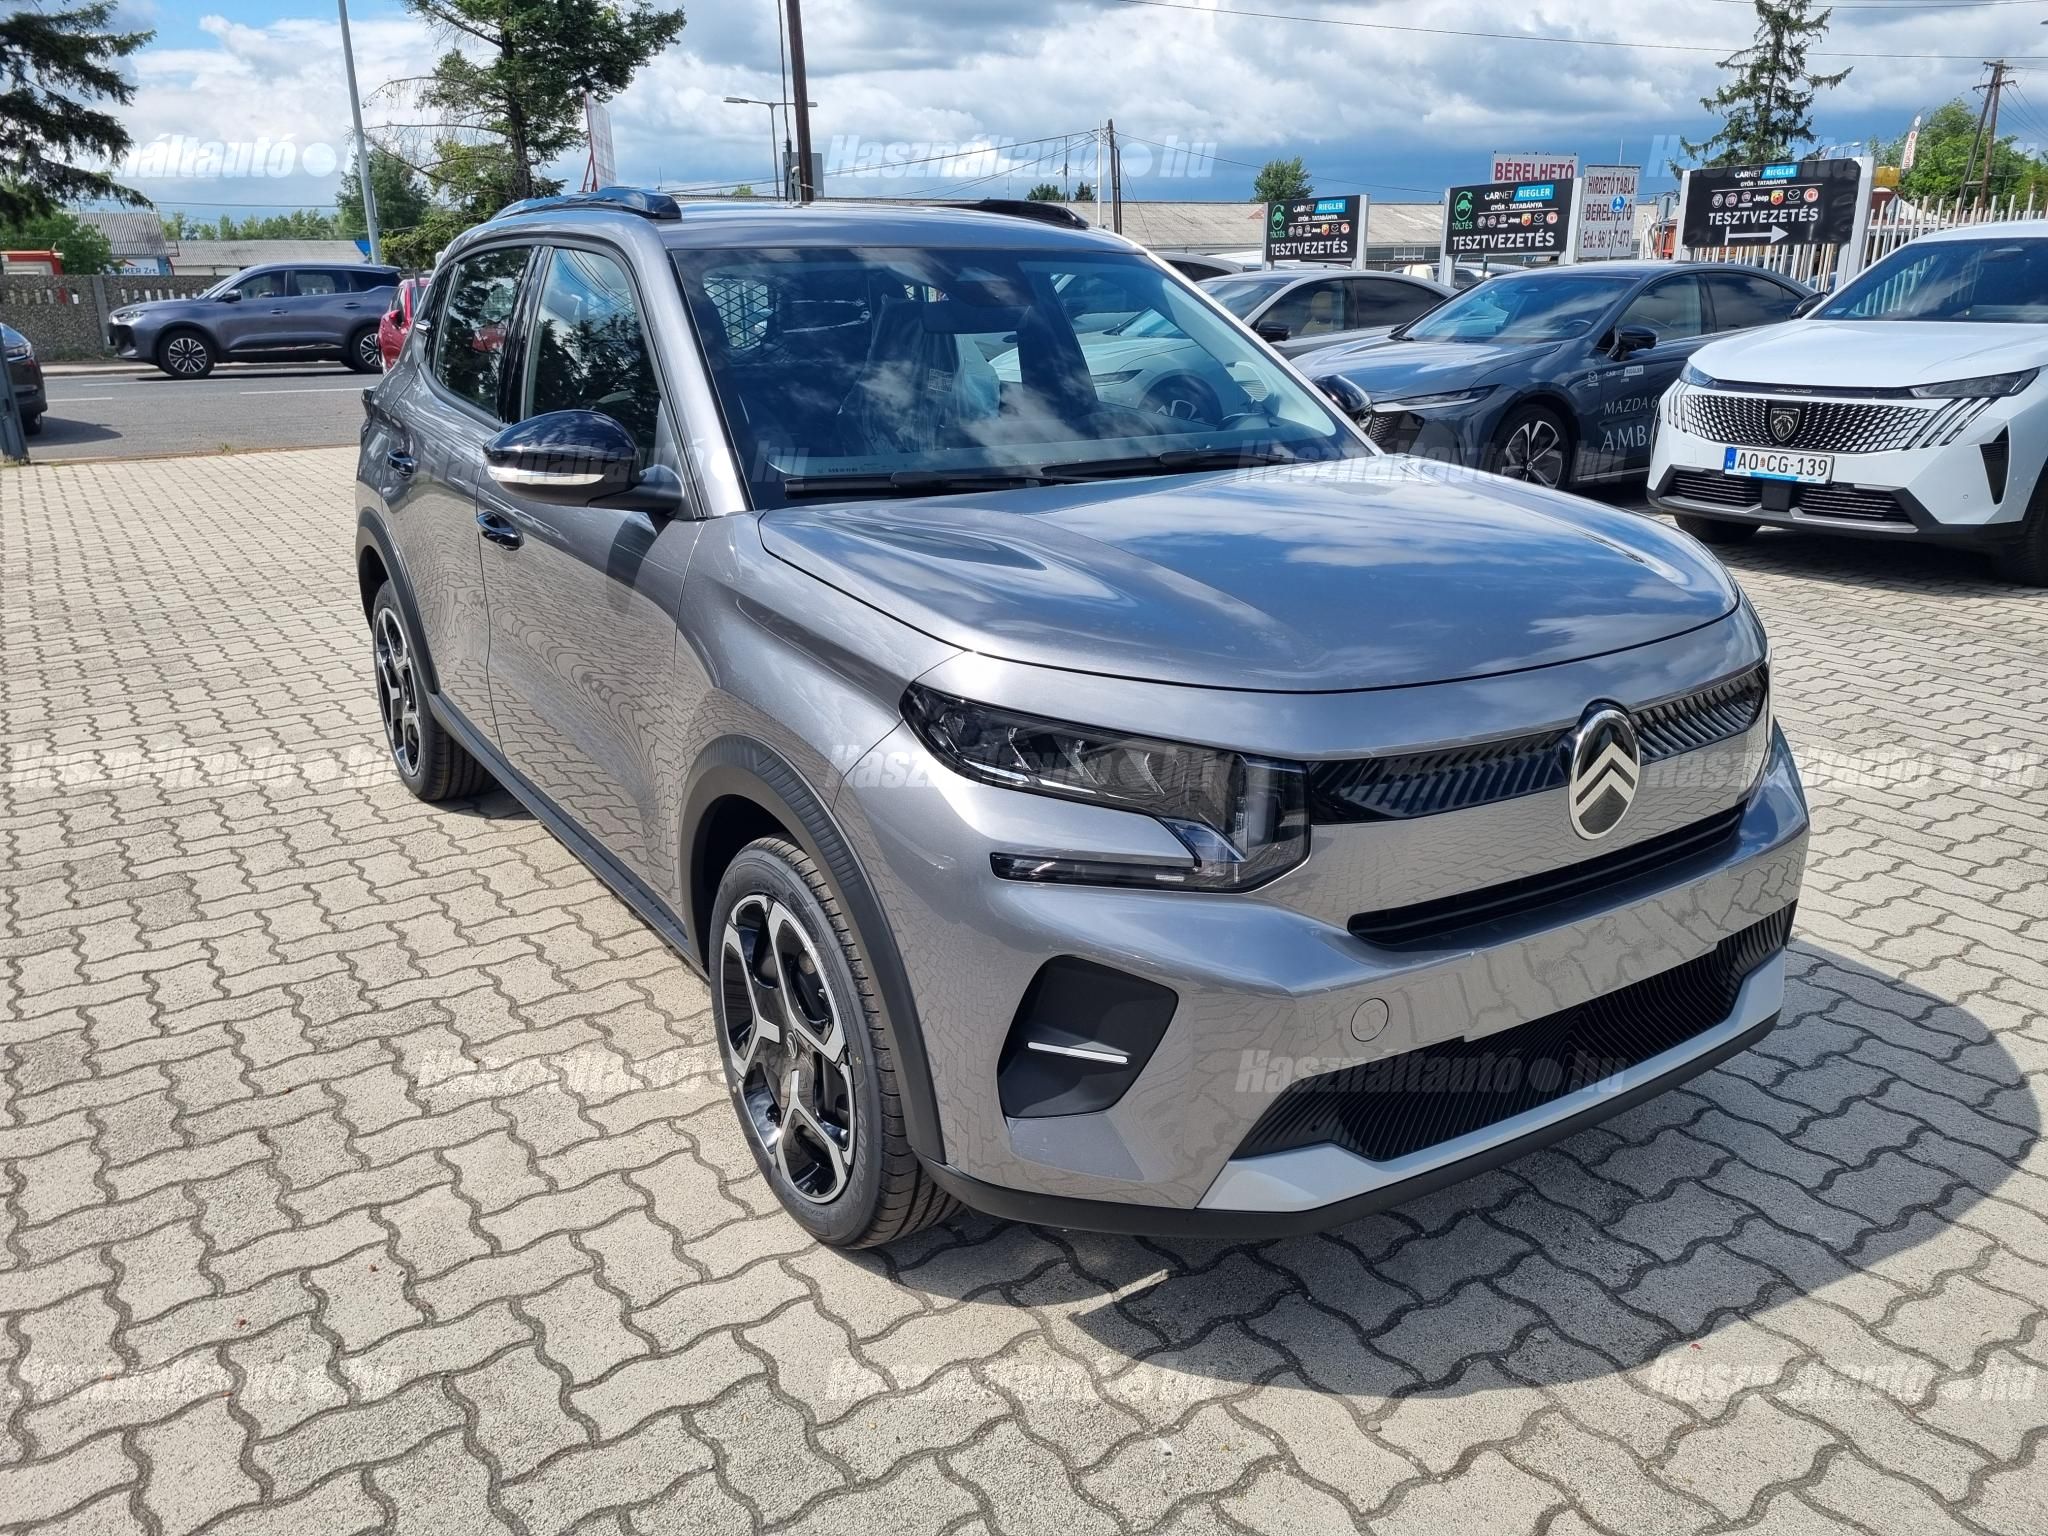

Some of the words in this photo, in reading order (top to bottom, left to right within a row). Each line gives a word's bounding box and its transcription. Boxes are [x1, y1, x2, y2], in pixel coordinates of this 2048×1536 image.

[1495, 158, 1574, 181] BÉRELHETŐ
[1735, 170, 1762, 179] CARNET
[1766, 167, 1795, 177] RIEGLER
[1757, 179, 1788, 187] TATABÁNYA
[1485, 190, 1514, 200] CARNET
[1518, 188, 1551, 198] RIEGLER
[1753, 195, 1769, 203] Jeep
[1293, 204, 1315, 213] CARNET
[1318, 202, 1344, 211] RIEGLER
[1509, 201, 1543, 210] TATABÁNYA
[1708, 205, 1819, 226] TESZTVEZETÉS
[1271, 237, 1348, 256] TESZTVEZETÉS
[1453, 229, 1555, 250] TESZTVEZETÉS
[1603, 397, 1648, 416] MAZDA
[1766, 455, 1828, 477] CG-139
